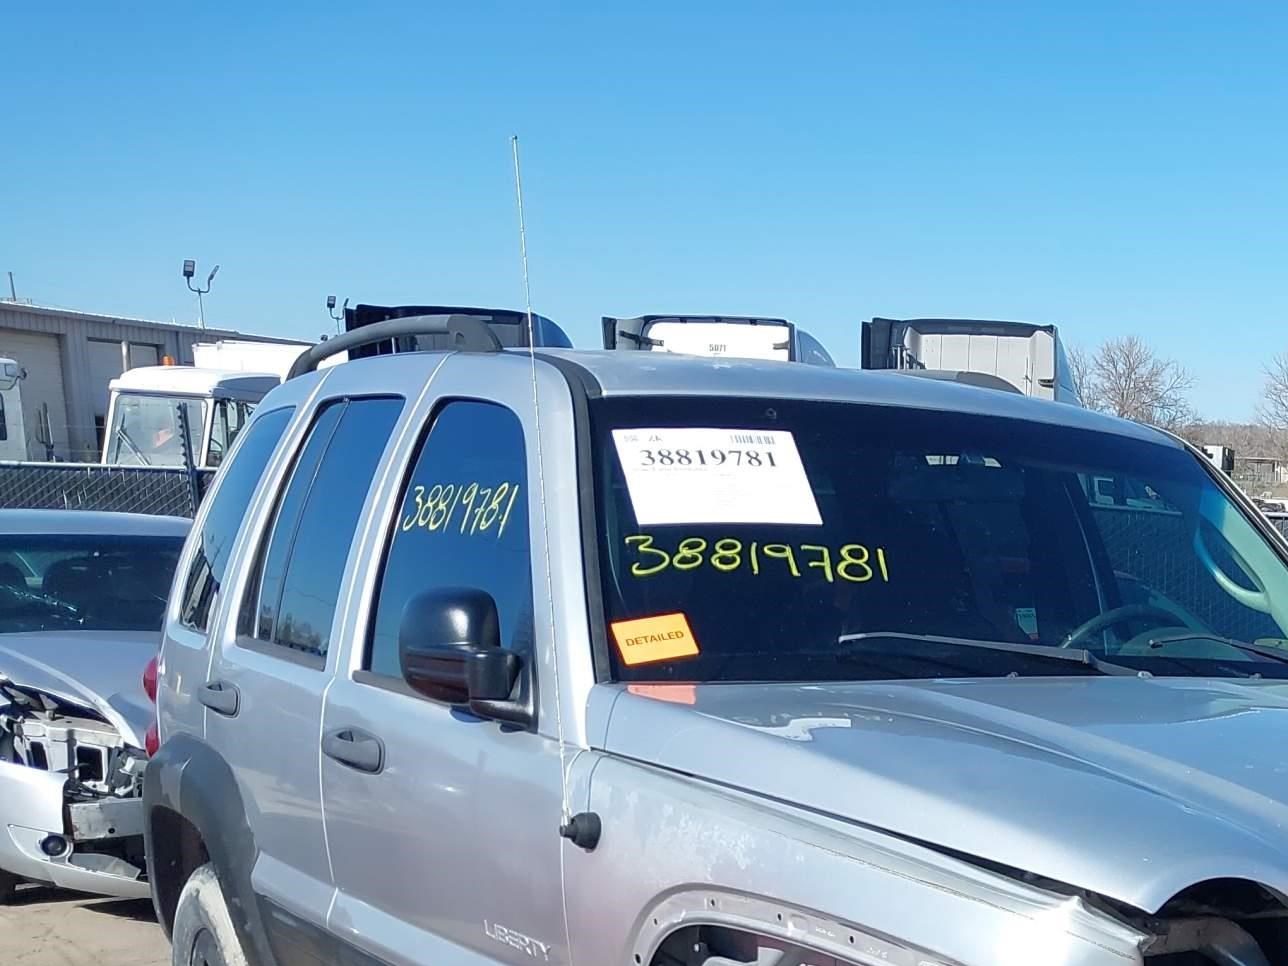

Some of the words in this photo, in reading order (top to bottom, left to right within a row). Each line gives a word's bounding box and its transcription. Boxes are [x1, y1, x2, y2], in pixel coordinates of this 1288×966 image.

[640, 449, 777, 467] 38819781
[403, 482, 519, 538] 38819781
[624, 535, 888, 582] 38819781
[625, 630, 685, 647] DETAILED
[483, 919, 551, 961] LIBERTY
